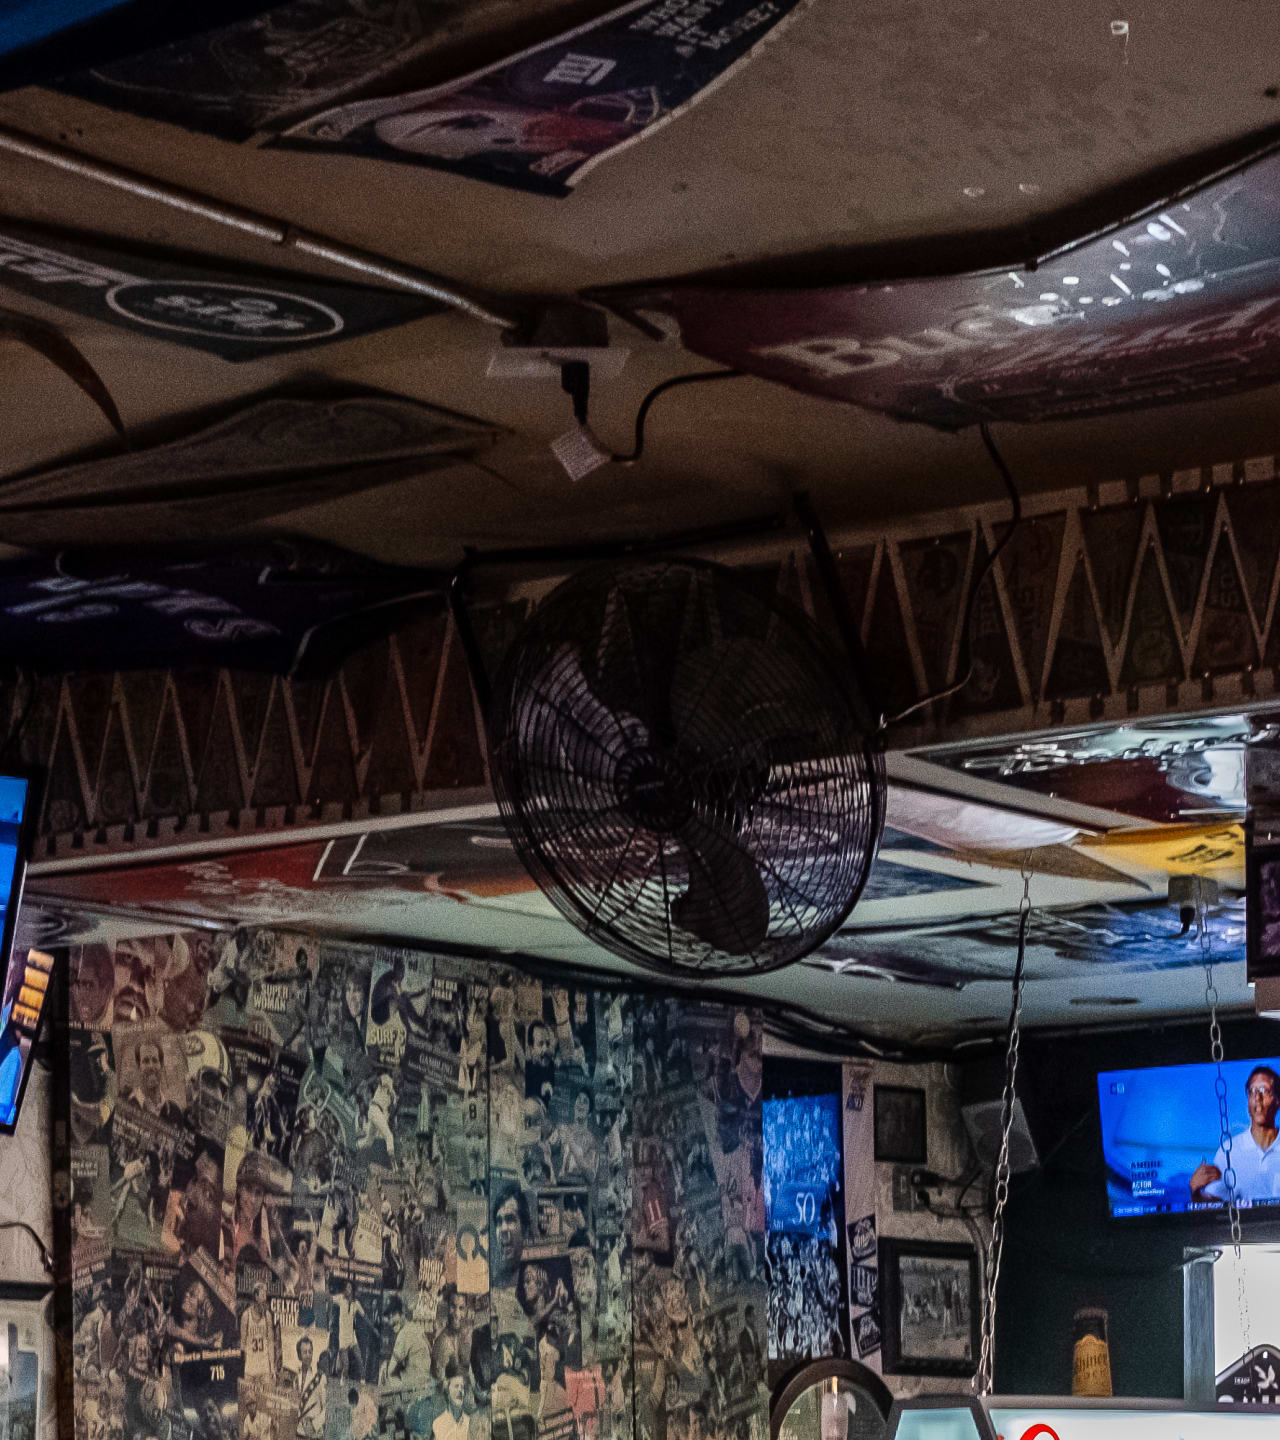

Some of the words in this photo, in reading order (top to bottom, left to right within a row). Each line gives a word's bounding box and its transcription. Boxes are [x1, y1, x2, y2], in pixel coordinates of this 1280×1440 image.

[792, 1191, 816, 1226] 50
[270, 1297, 298, 1313] CELTIC
[252, 1338, 265, 1352] 33
